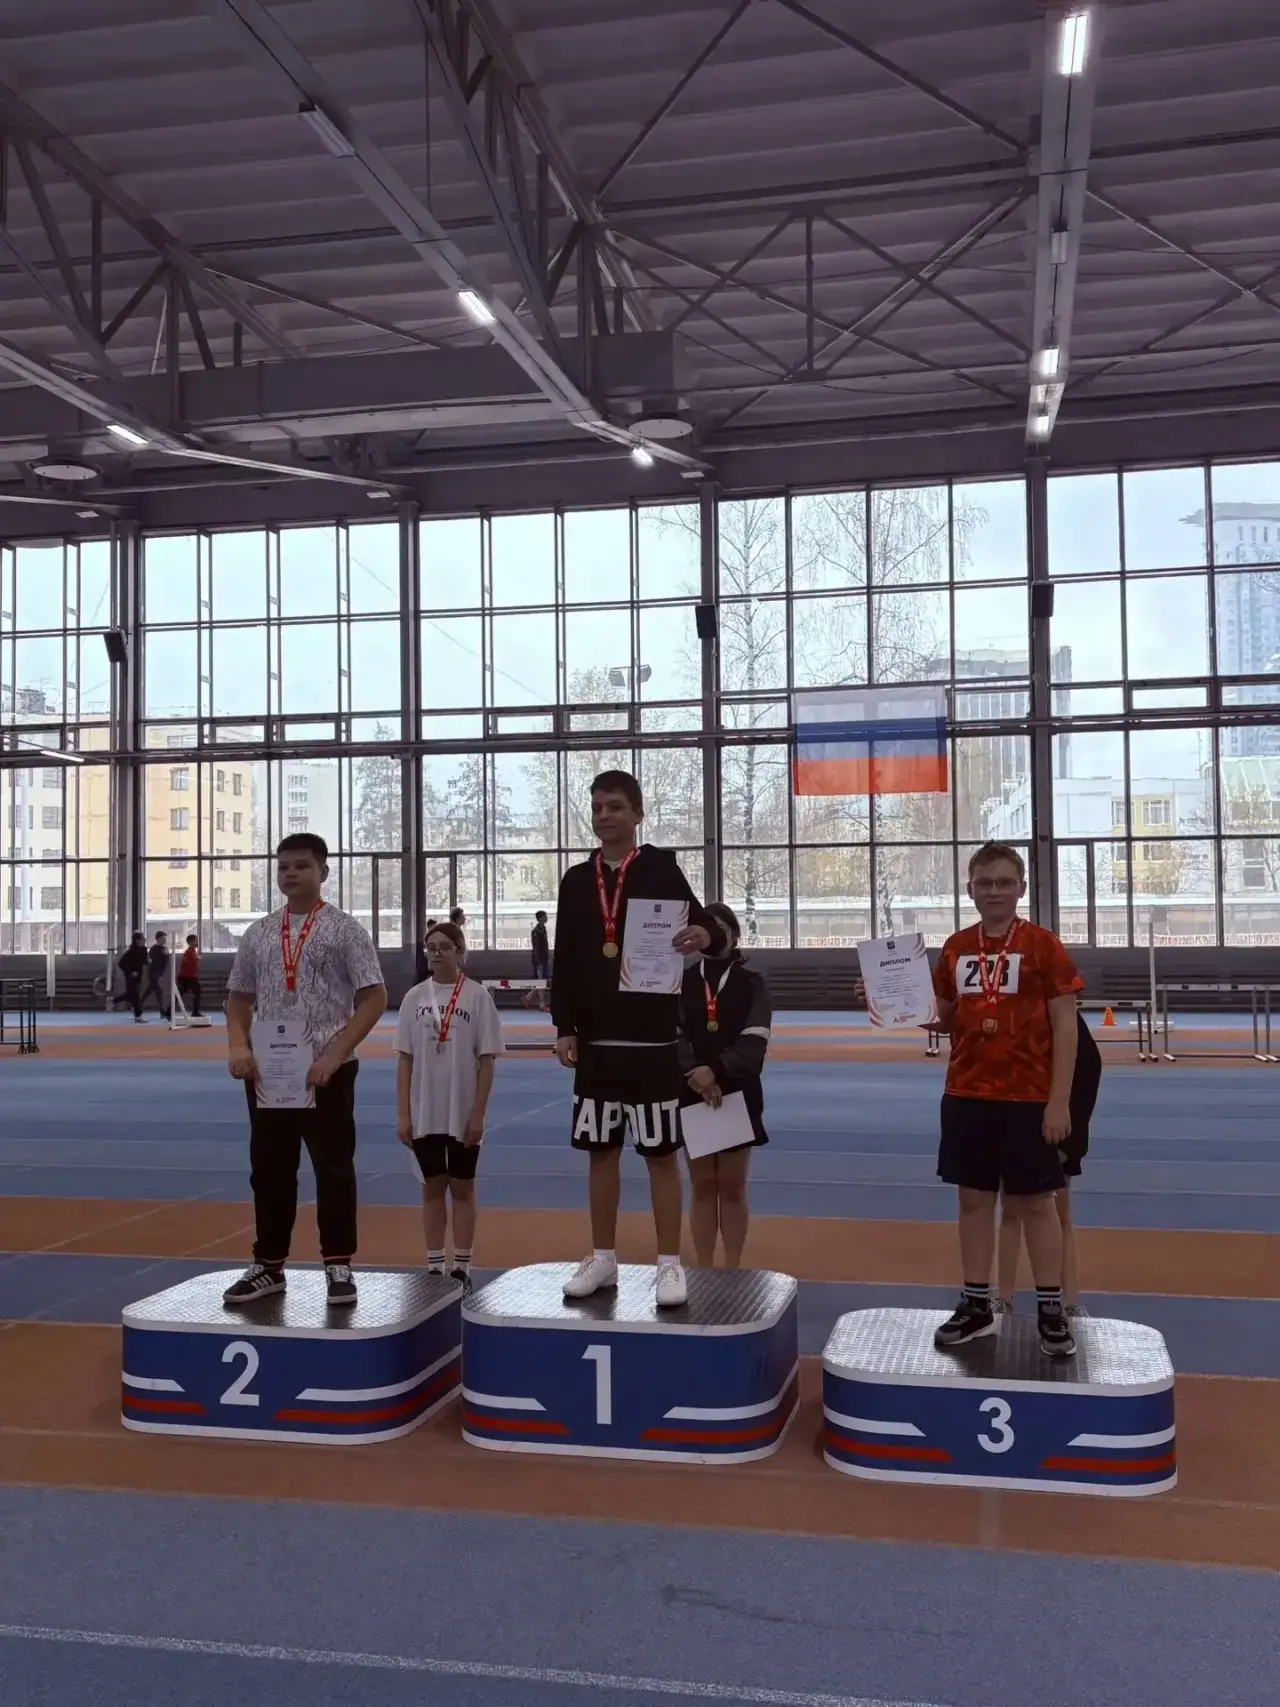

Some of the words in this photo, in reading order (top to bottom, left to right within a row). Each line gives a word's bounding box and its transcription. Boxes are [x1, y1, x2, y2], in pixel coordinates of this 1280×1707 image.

[879, 957, 911, 967] ДИПЛОМ
[415, 1004, 471, 1024] Creaon
[219, 1341, 261, 1407] 2
[581, 1345, 612, 1425] 1
[976, 1396, 1015, 1454] 3
